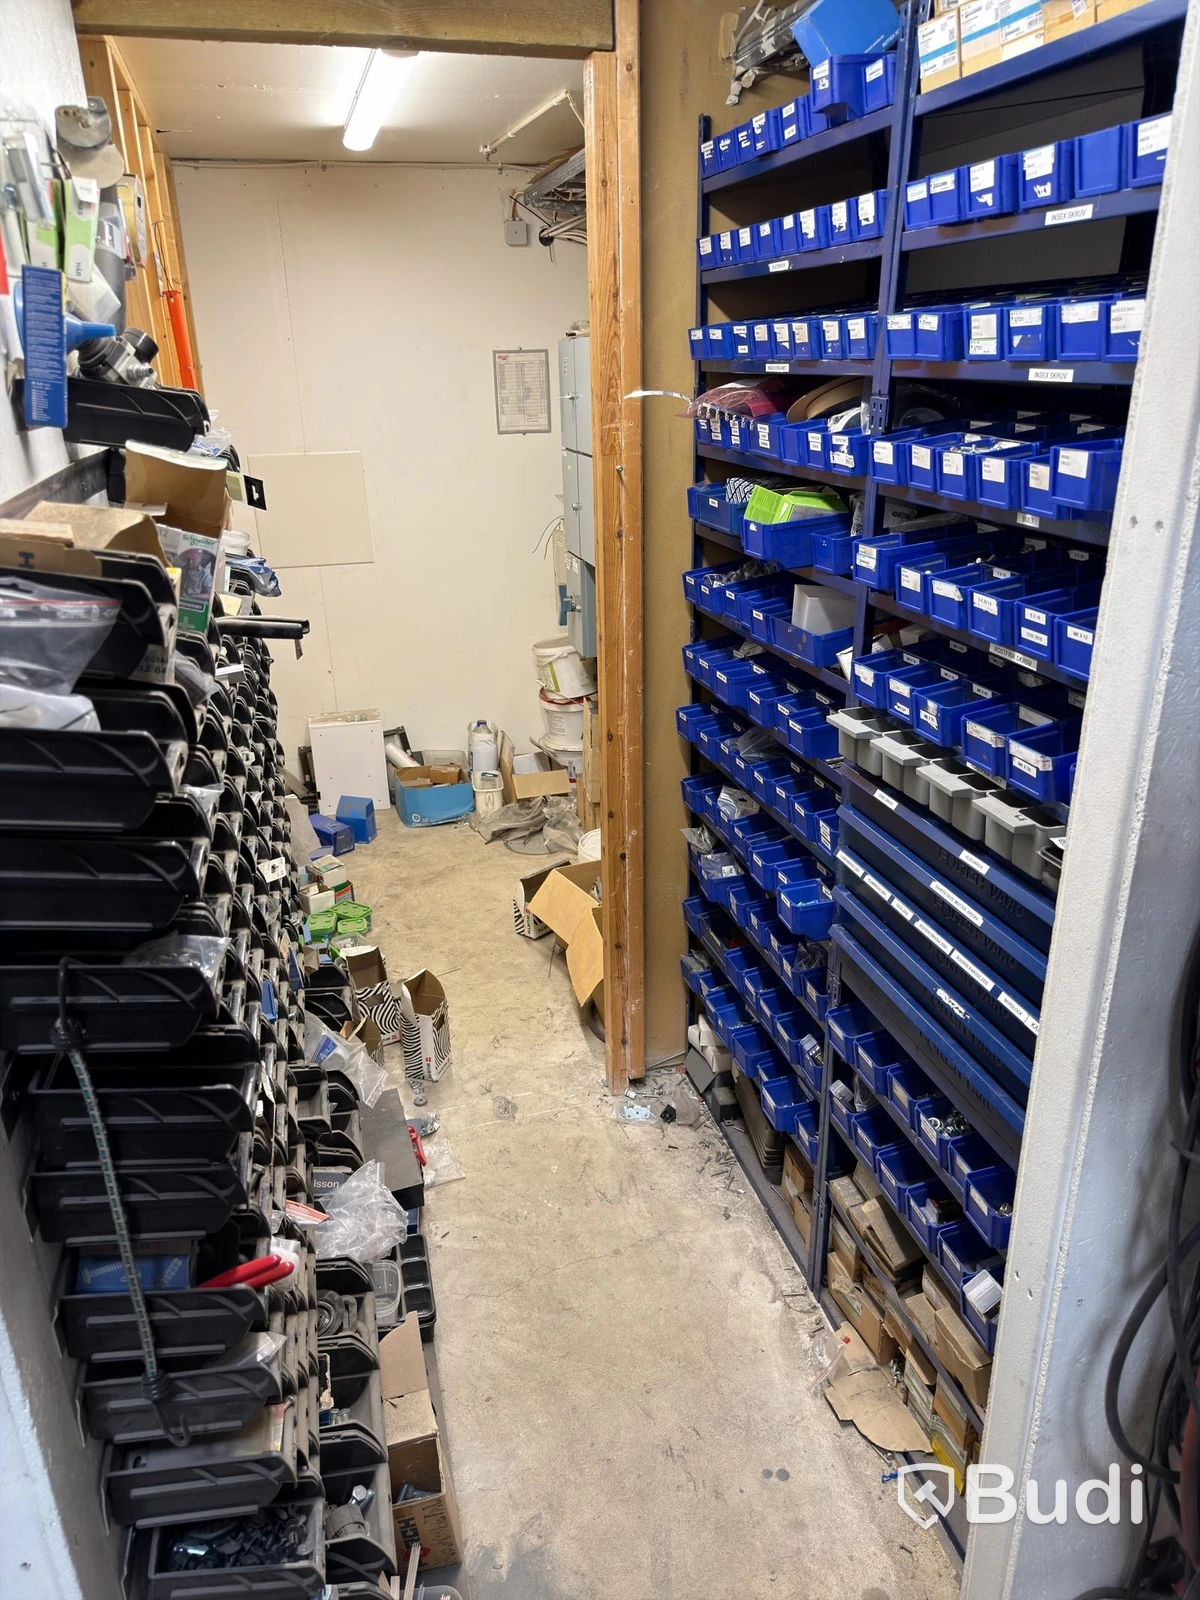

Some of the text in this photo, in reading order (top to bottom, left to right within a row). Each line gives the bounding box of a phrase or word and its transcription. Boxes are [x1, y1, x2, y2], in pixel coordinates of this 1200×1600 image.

[1050, 208, 1087, 221] INSEX SKRUV
[1034, 371, 1068, 380] INSEX SKRUV
[182, 533, 215, 546] Schneider
